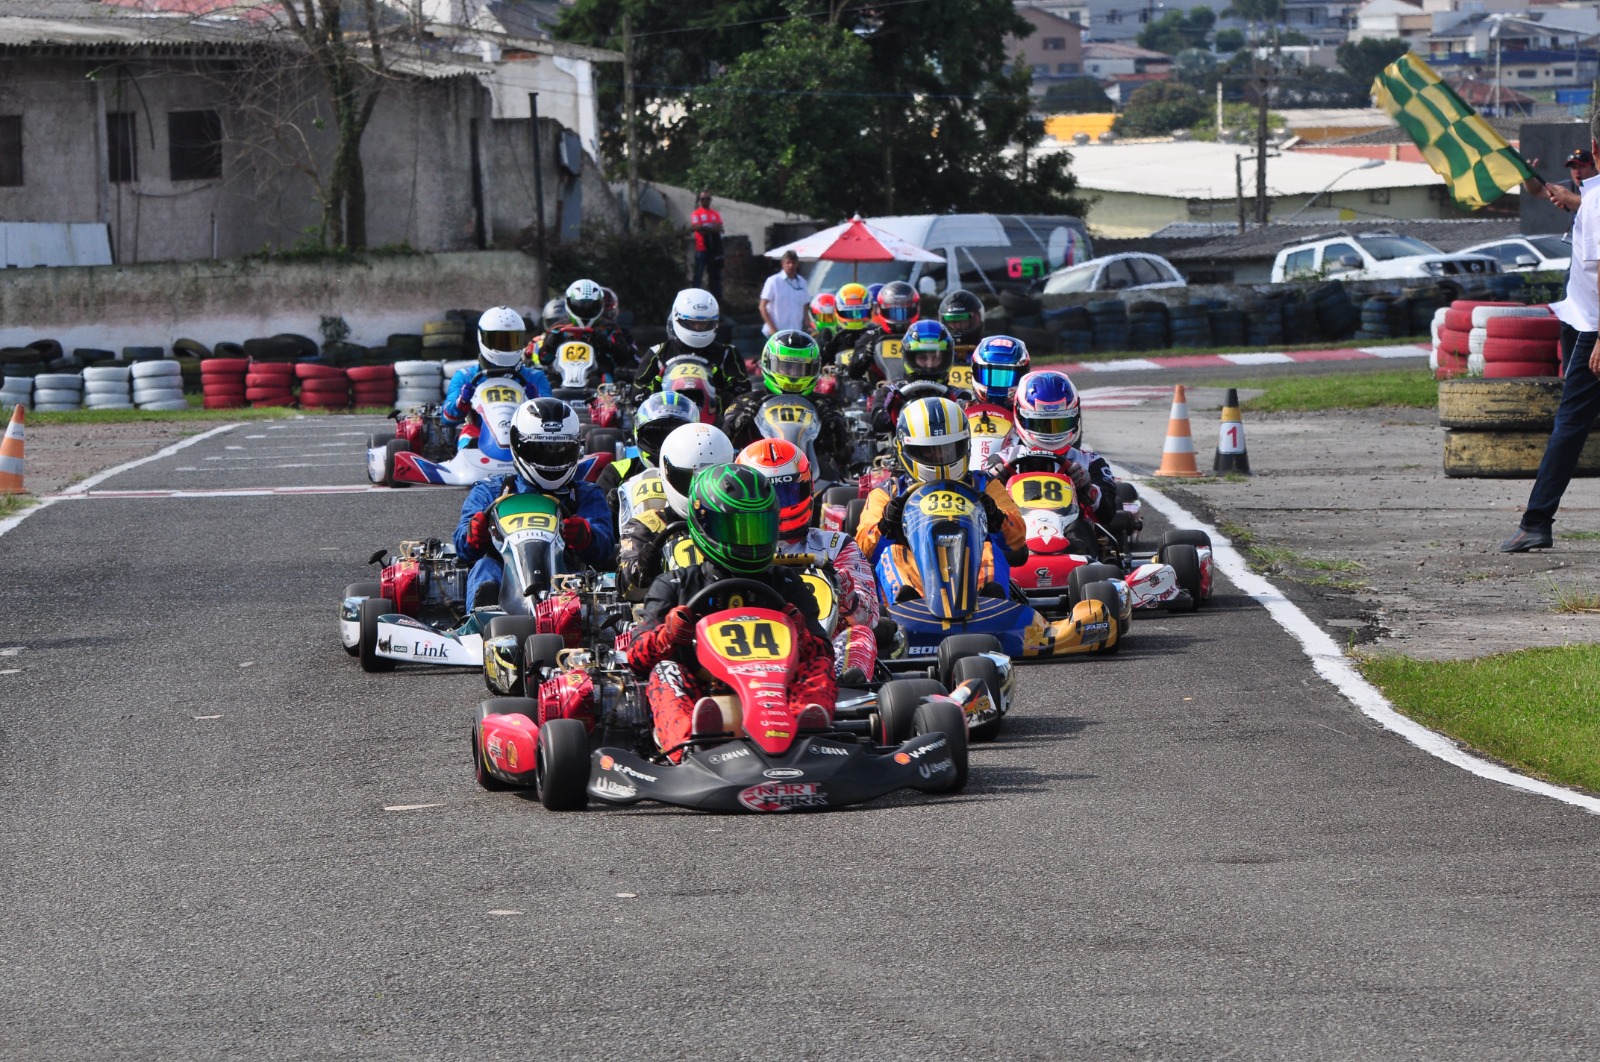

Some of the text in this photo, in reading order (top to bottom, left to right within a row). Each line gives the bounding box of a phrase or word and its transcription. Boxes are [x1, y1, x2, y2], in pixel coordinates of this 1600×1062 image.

[566, 346, 587, 360] 62
[679, 366, 700, 376] 22
[486, 389, 517, 403] 03
[770, 407, 806, 423] 107
[974, 423, 997, 433] 48
[1226, 426, 1237, 448] 1
[636, 481, 664, 496] 40
[928, 493, 966, 511] 333
[508, 515, 550, 529] 19
[720, 623, 780, 657] 34
[413, 640, 450, 658] Link
[721, 748, 750, 761] DIANA
[821, 746, 849, 756] DIANA
[613, 762, 658, 783] V-Power
[758, 782, 821, 796] KART
